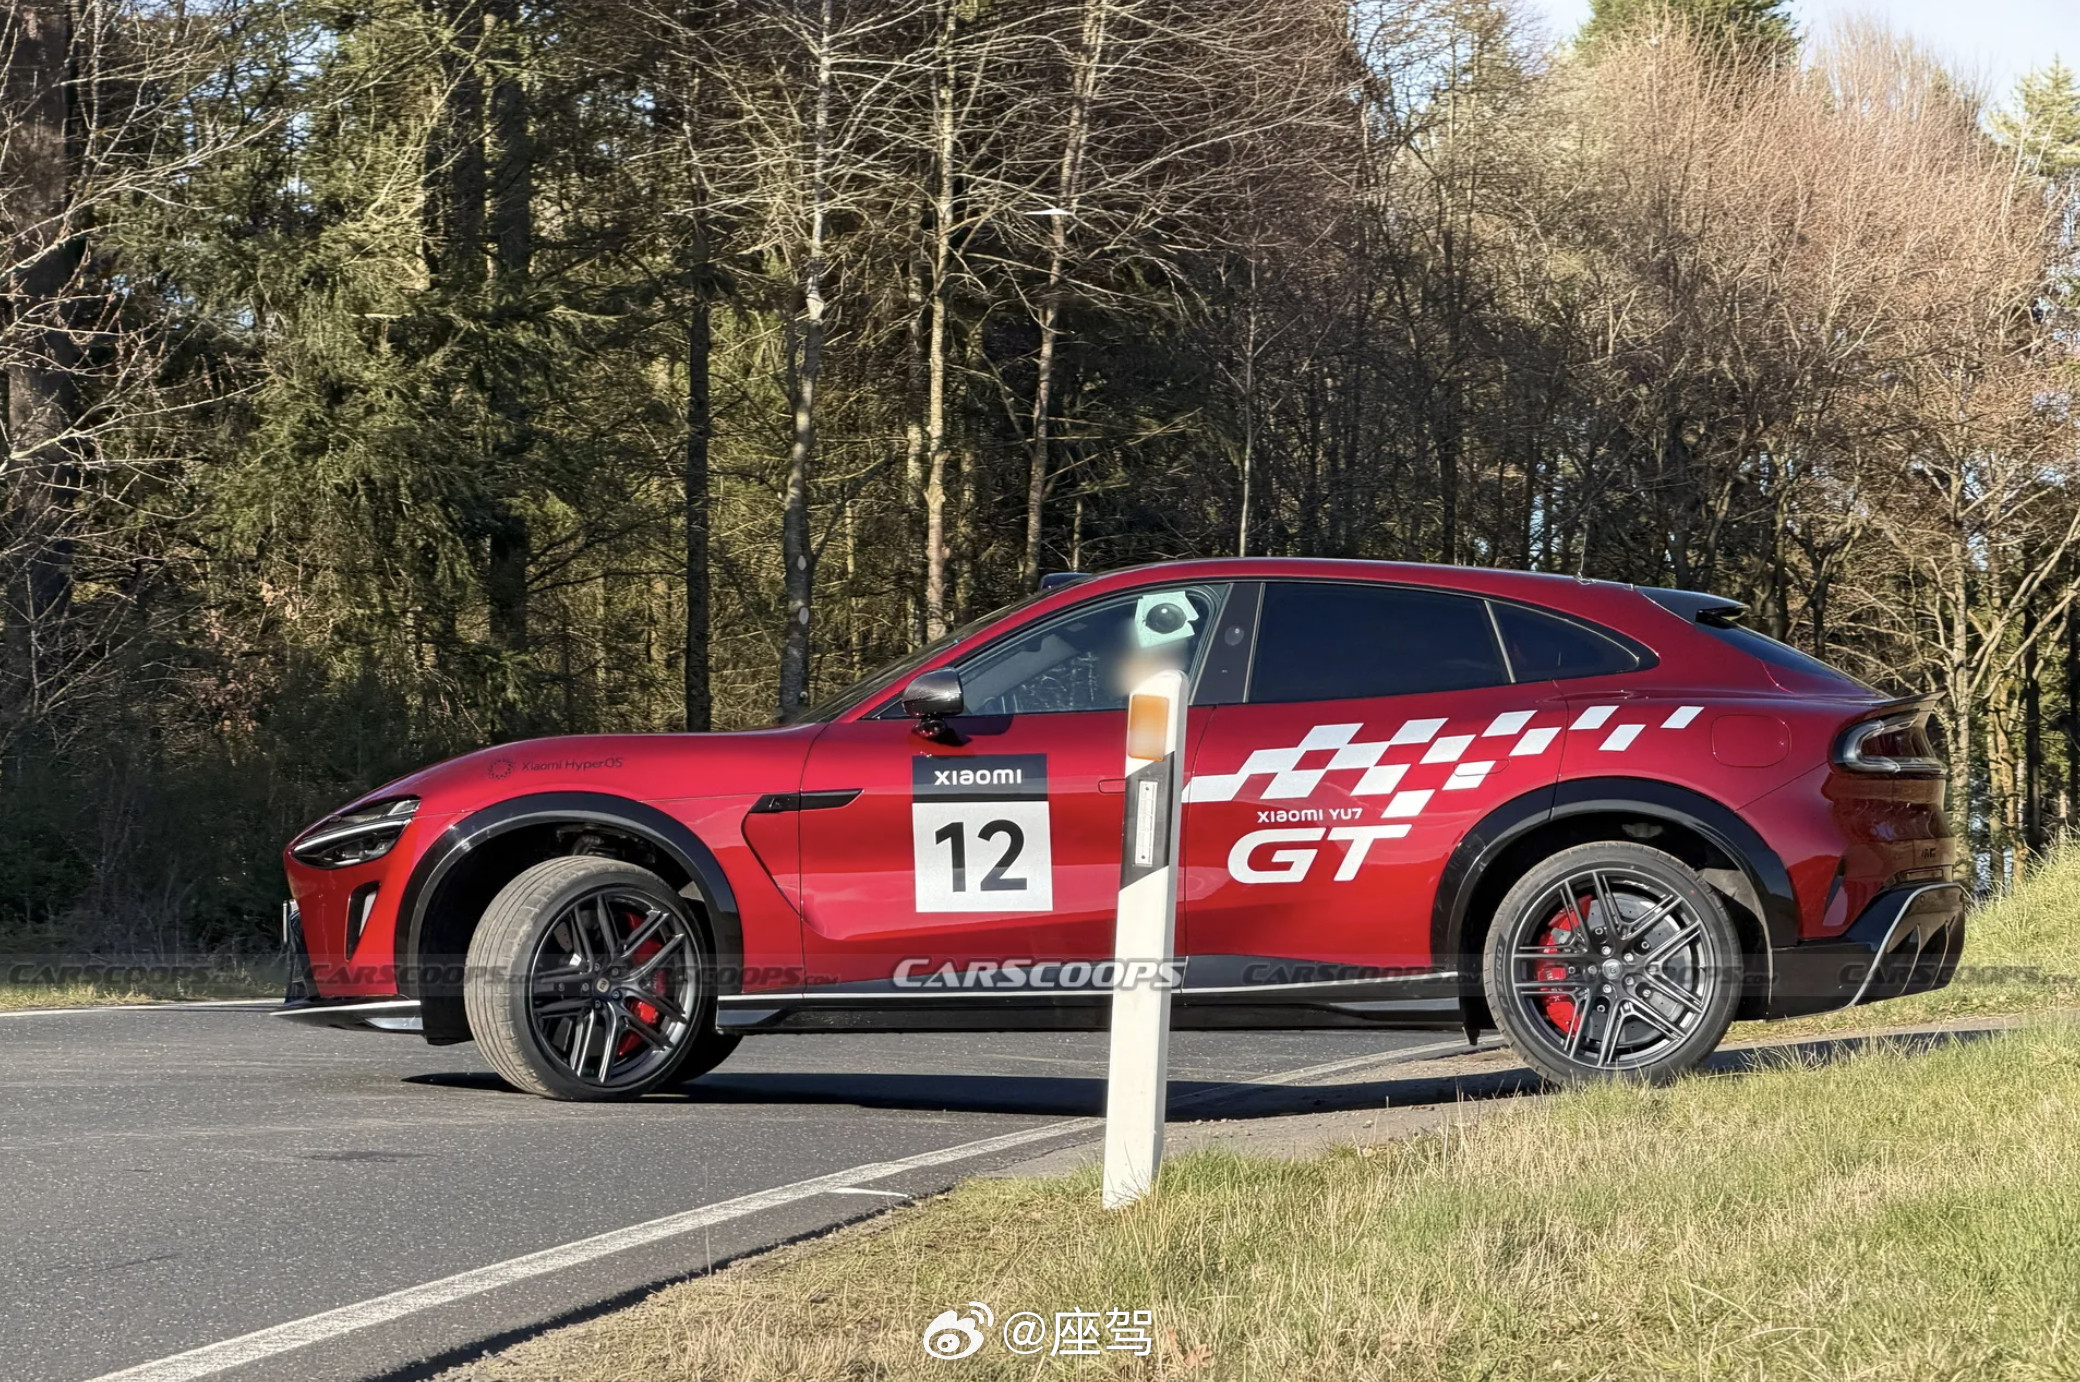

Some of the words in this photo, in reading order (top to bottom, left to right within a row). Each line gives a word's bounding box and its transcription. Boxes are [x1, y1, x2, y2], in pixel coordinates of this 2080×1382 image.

[522, 761, 562, 771] Xiaomi
[564, 757, 623, 772] HyperOS
[1329, 807, 1363, 820] YU7
[935, 819, 1028, 893] 12
[1227, 824, 1412, 884] GT
